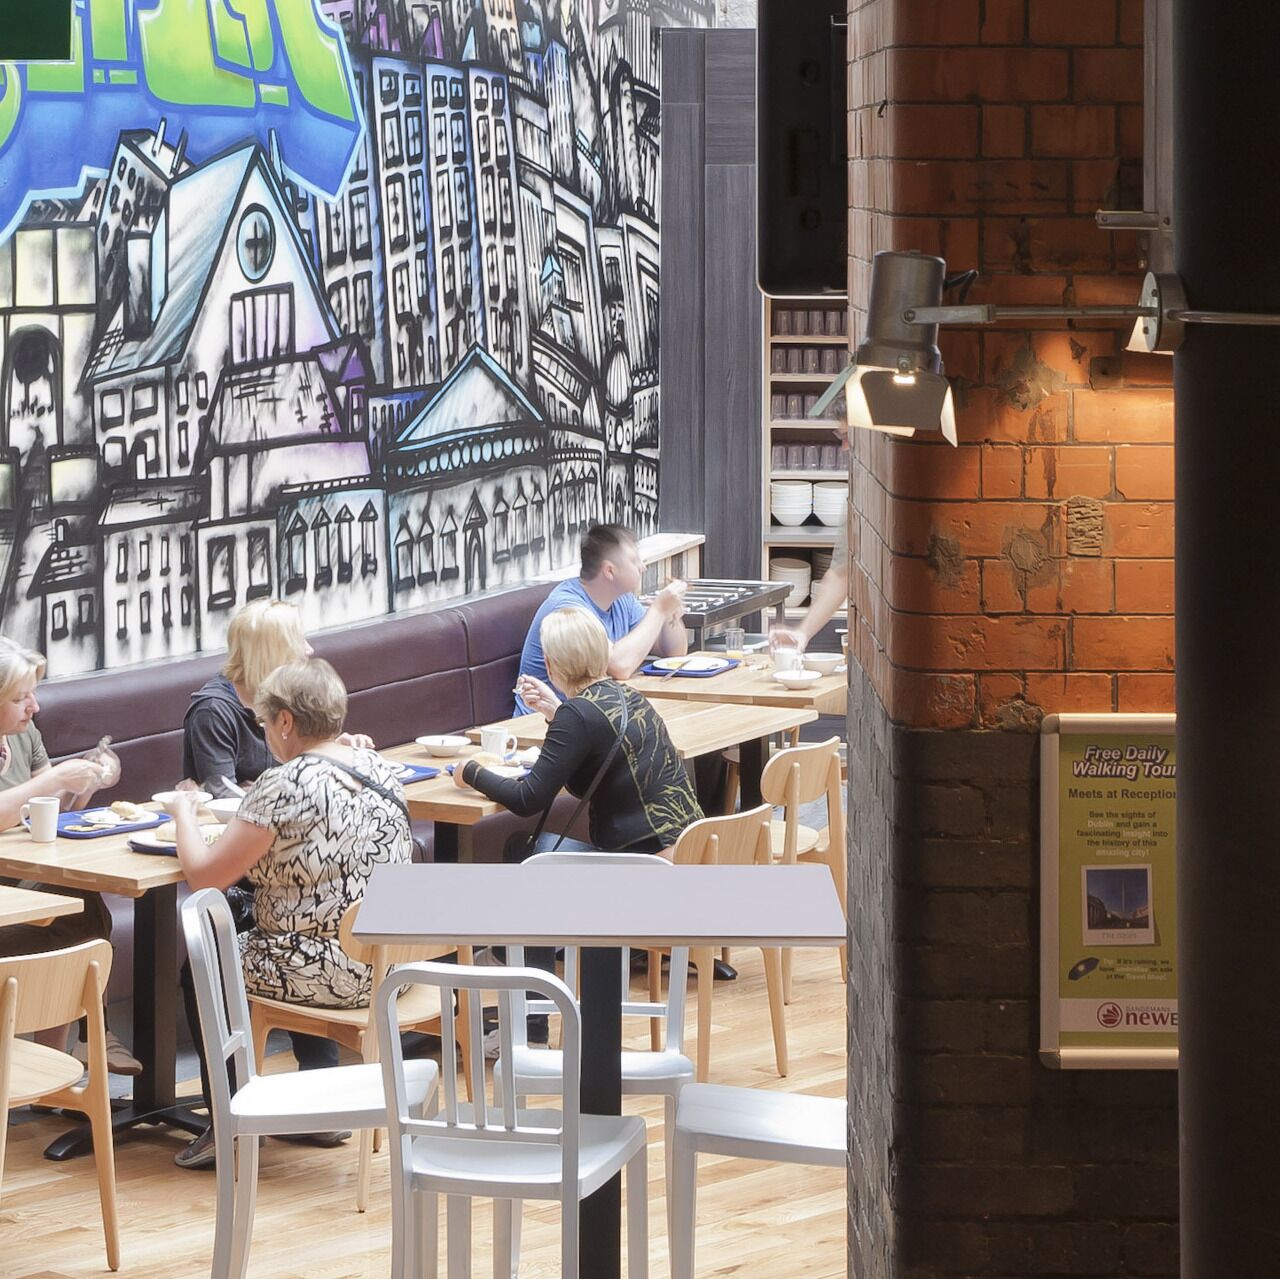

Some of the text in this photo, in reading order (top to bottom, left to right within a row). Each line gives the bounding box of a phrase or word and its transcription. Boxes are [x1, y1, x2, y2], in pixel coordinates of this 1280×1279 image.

[1085, 745, 1168, 763] Free Daily
[1072, 761, 1138, 781] Walking
[1068, 789, 1103, 799] Meets
[1107, 789, 1117, 799] at
[1121, 811, 1145, 820] sights
[1133, 821, 1150, 829] gain
[1076, 829, 1121, 838] fascinating
[1102, 839, 1130, 848] history
